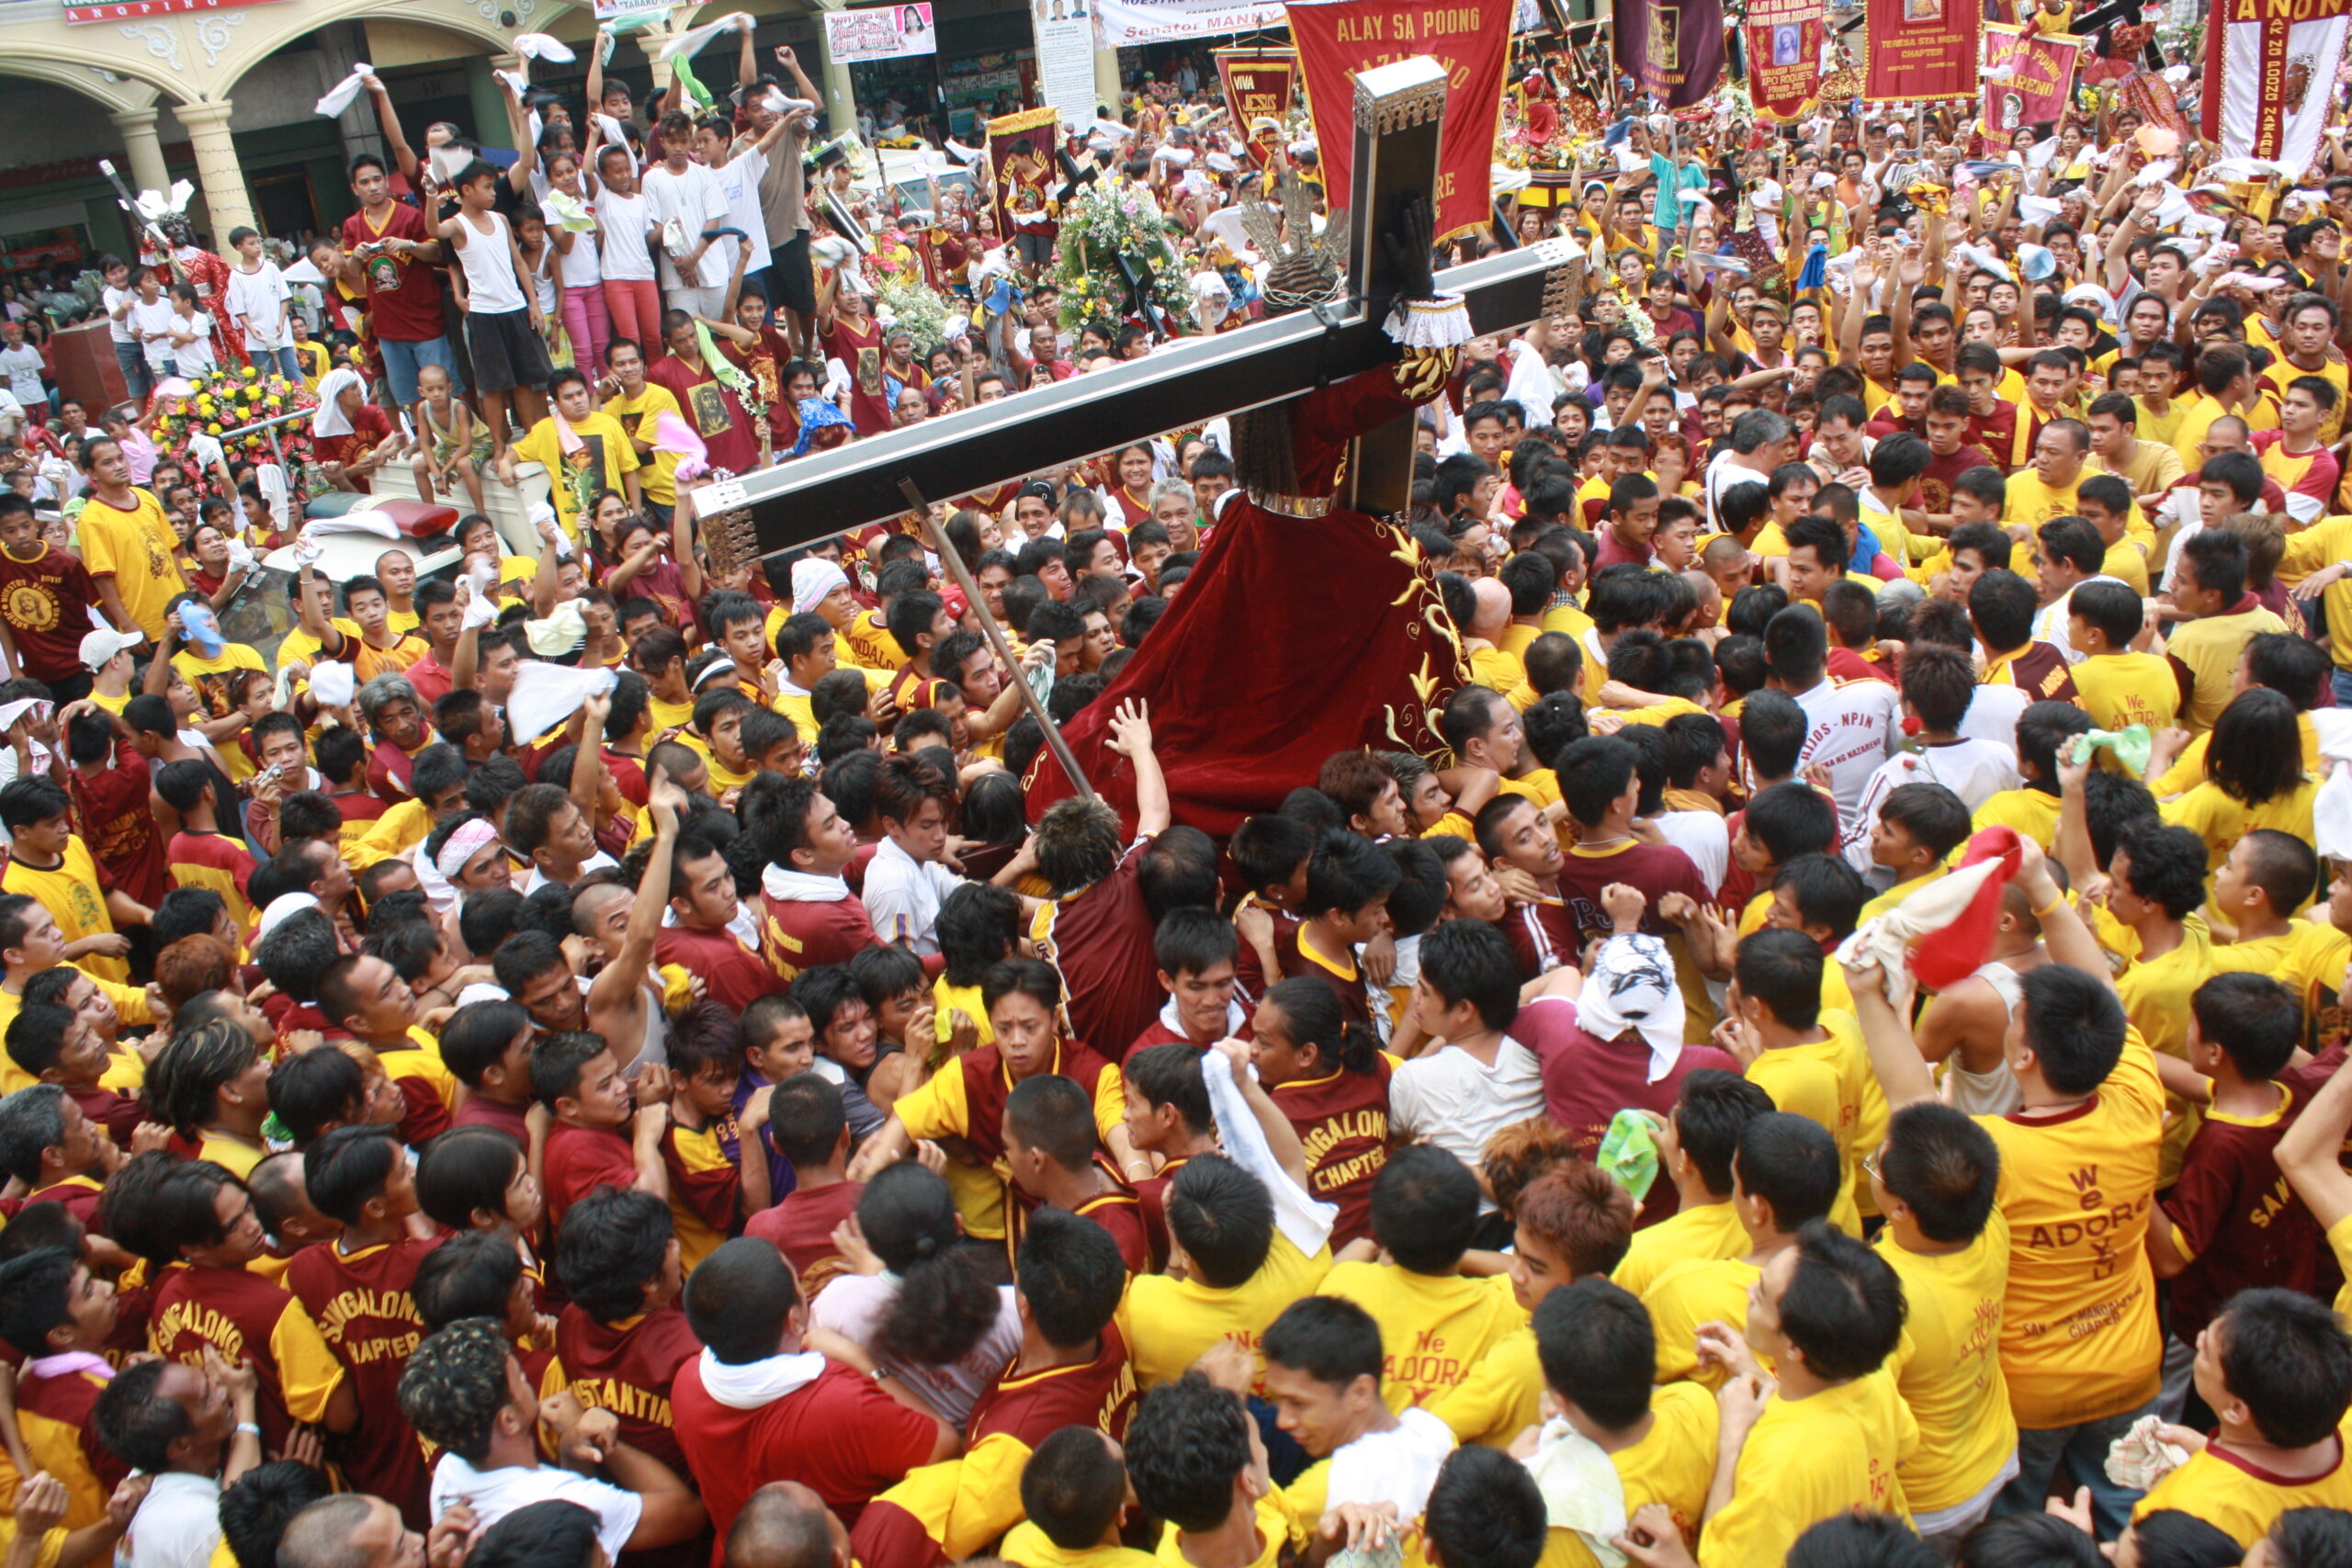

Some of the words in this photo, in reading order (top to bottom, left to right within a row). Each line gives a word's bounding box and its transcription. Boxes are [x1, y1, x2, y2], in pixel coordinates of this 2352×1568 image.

[1125, 21, 1200, 39] Senator
[1206, 10, 1277, 29] MANNY
[1337, 14, 1384, 42] ALAY
[1392, 13, 1416, 40] SA
[1423, 6, 1481, 39] POONG
[1901, 48, 1944, 58] CHAPTER
[1918, 37, 1935, 46] STA
[2268, 39, 2283, 56] NG
[1233, 74, 1255, 90] VIVA
[2265, 61, 2281, 102] POONG
[1243, 94, 1277, 111] JESUS
[2258, 107, 2278, 162] NAZAREN
[2124, 694, 2145, 710] We
[1801, 722, 1832, 761] HIJOS
[1841, 712, 1874, 730] NPJN
[1302, 1110, 1388, 1175] INGALON
[1314, 1145, 1388, 1191] CHAPTER
[1416, 1328, 1446, 1354] We
